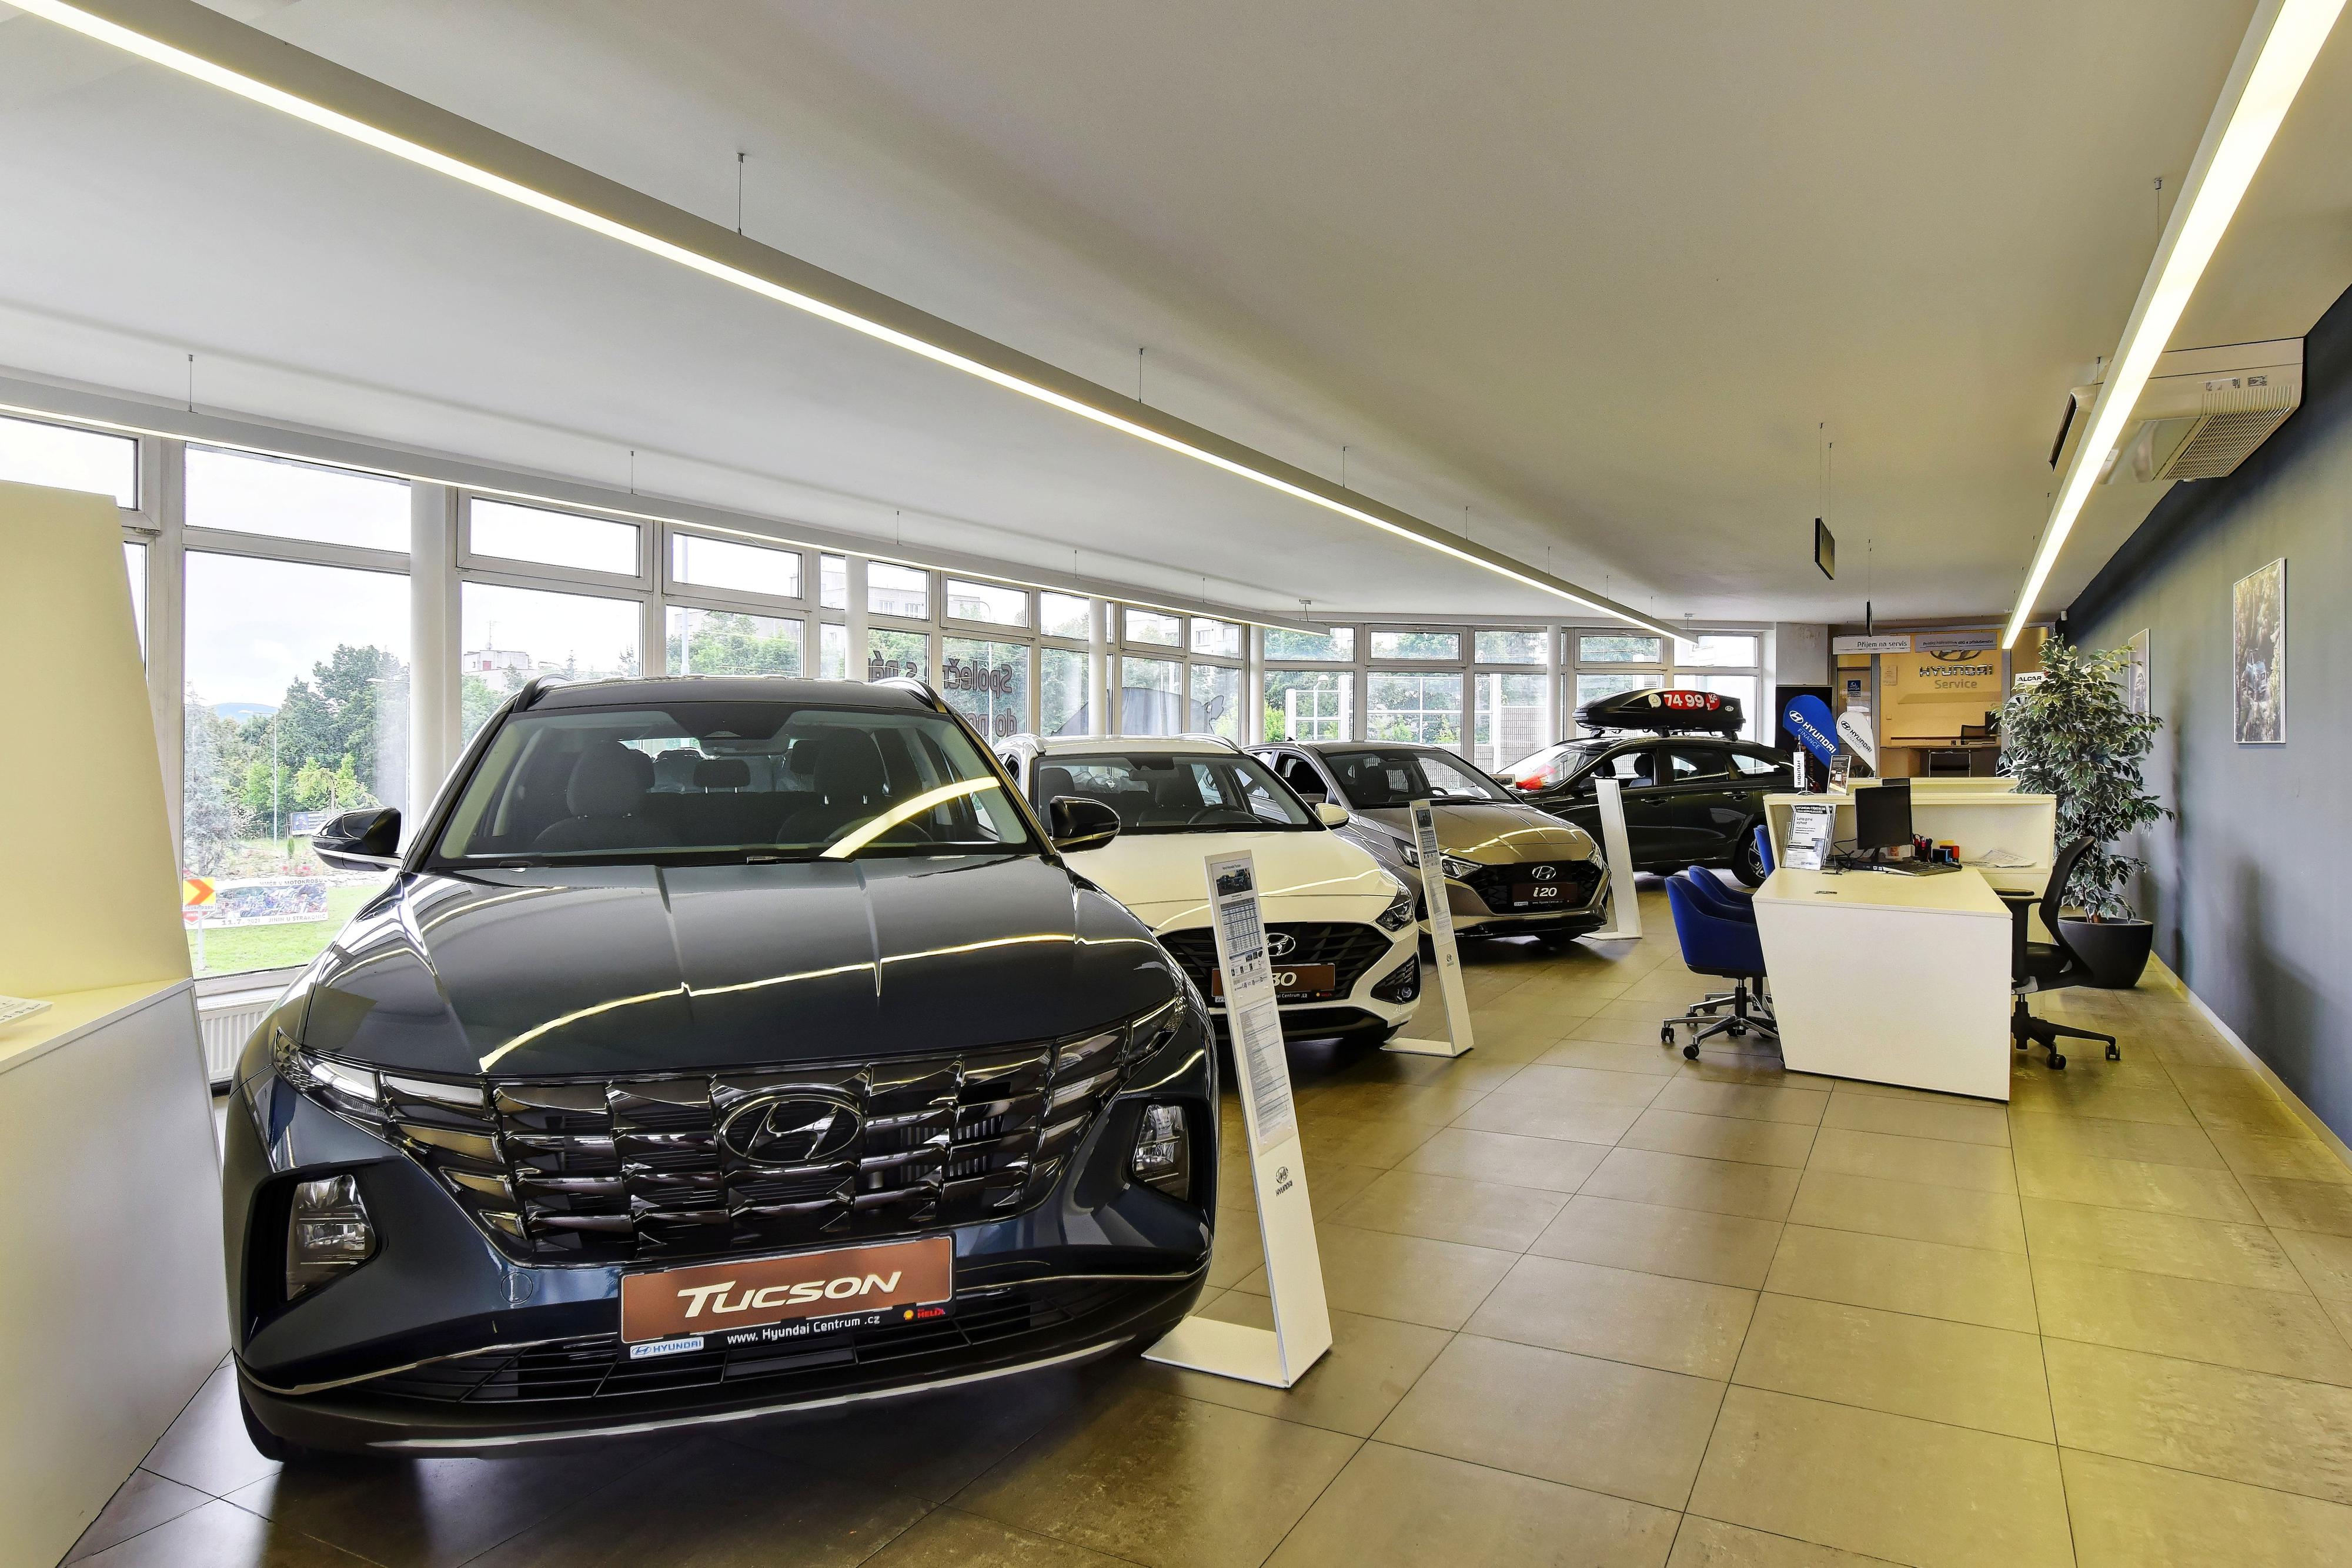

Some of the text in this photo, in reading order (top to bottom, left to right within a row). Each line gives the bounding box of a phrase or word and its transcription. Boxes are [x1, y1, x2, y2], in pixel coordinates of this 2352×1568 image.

[1919, 664, 1993, 677] HYUNDAI
[1935, 678, 1977, 689] Service
[1663, 694, 1683, 706] 74
[1797, 728, 1820, 750] FINANCE
[1803, 721, 1837, 754] HYUNDAI
[1847, 734, 1862, 750] FINANCE
[1849, 729, 1872, 753] HYUNDAI
[1533, 887, 1558, 897] i20
[1272, 972, 1297, 987] 30
[677, 1271, 903, 1318] TUCSON
[917, 1308, 946, 1319] HELIX
[727, 1332, 759, 1345] www.
[762, 1323, 810, 1341] Hyundai
[813, 1317, 861, 1332] Centrum
[653, 1340, 702, 1353] HYUNDAI
